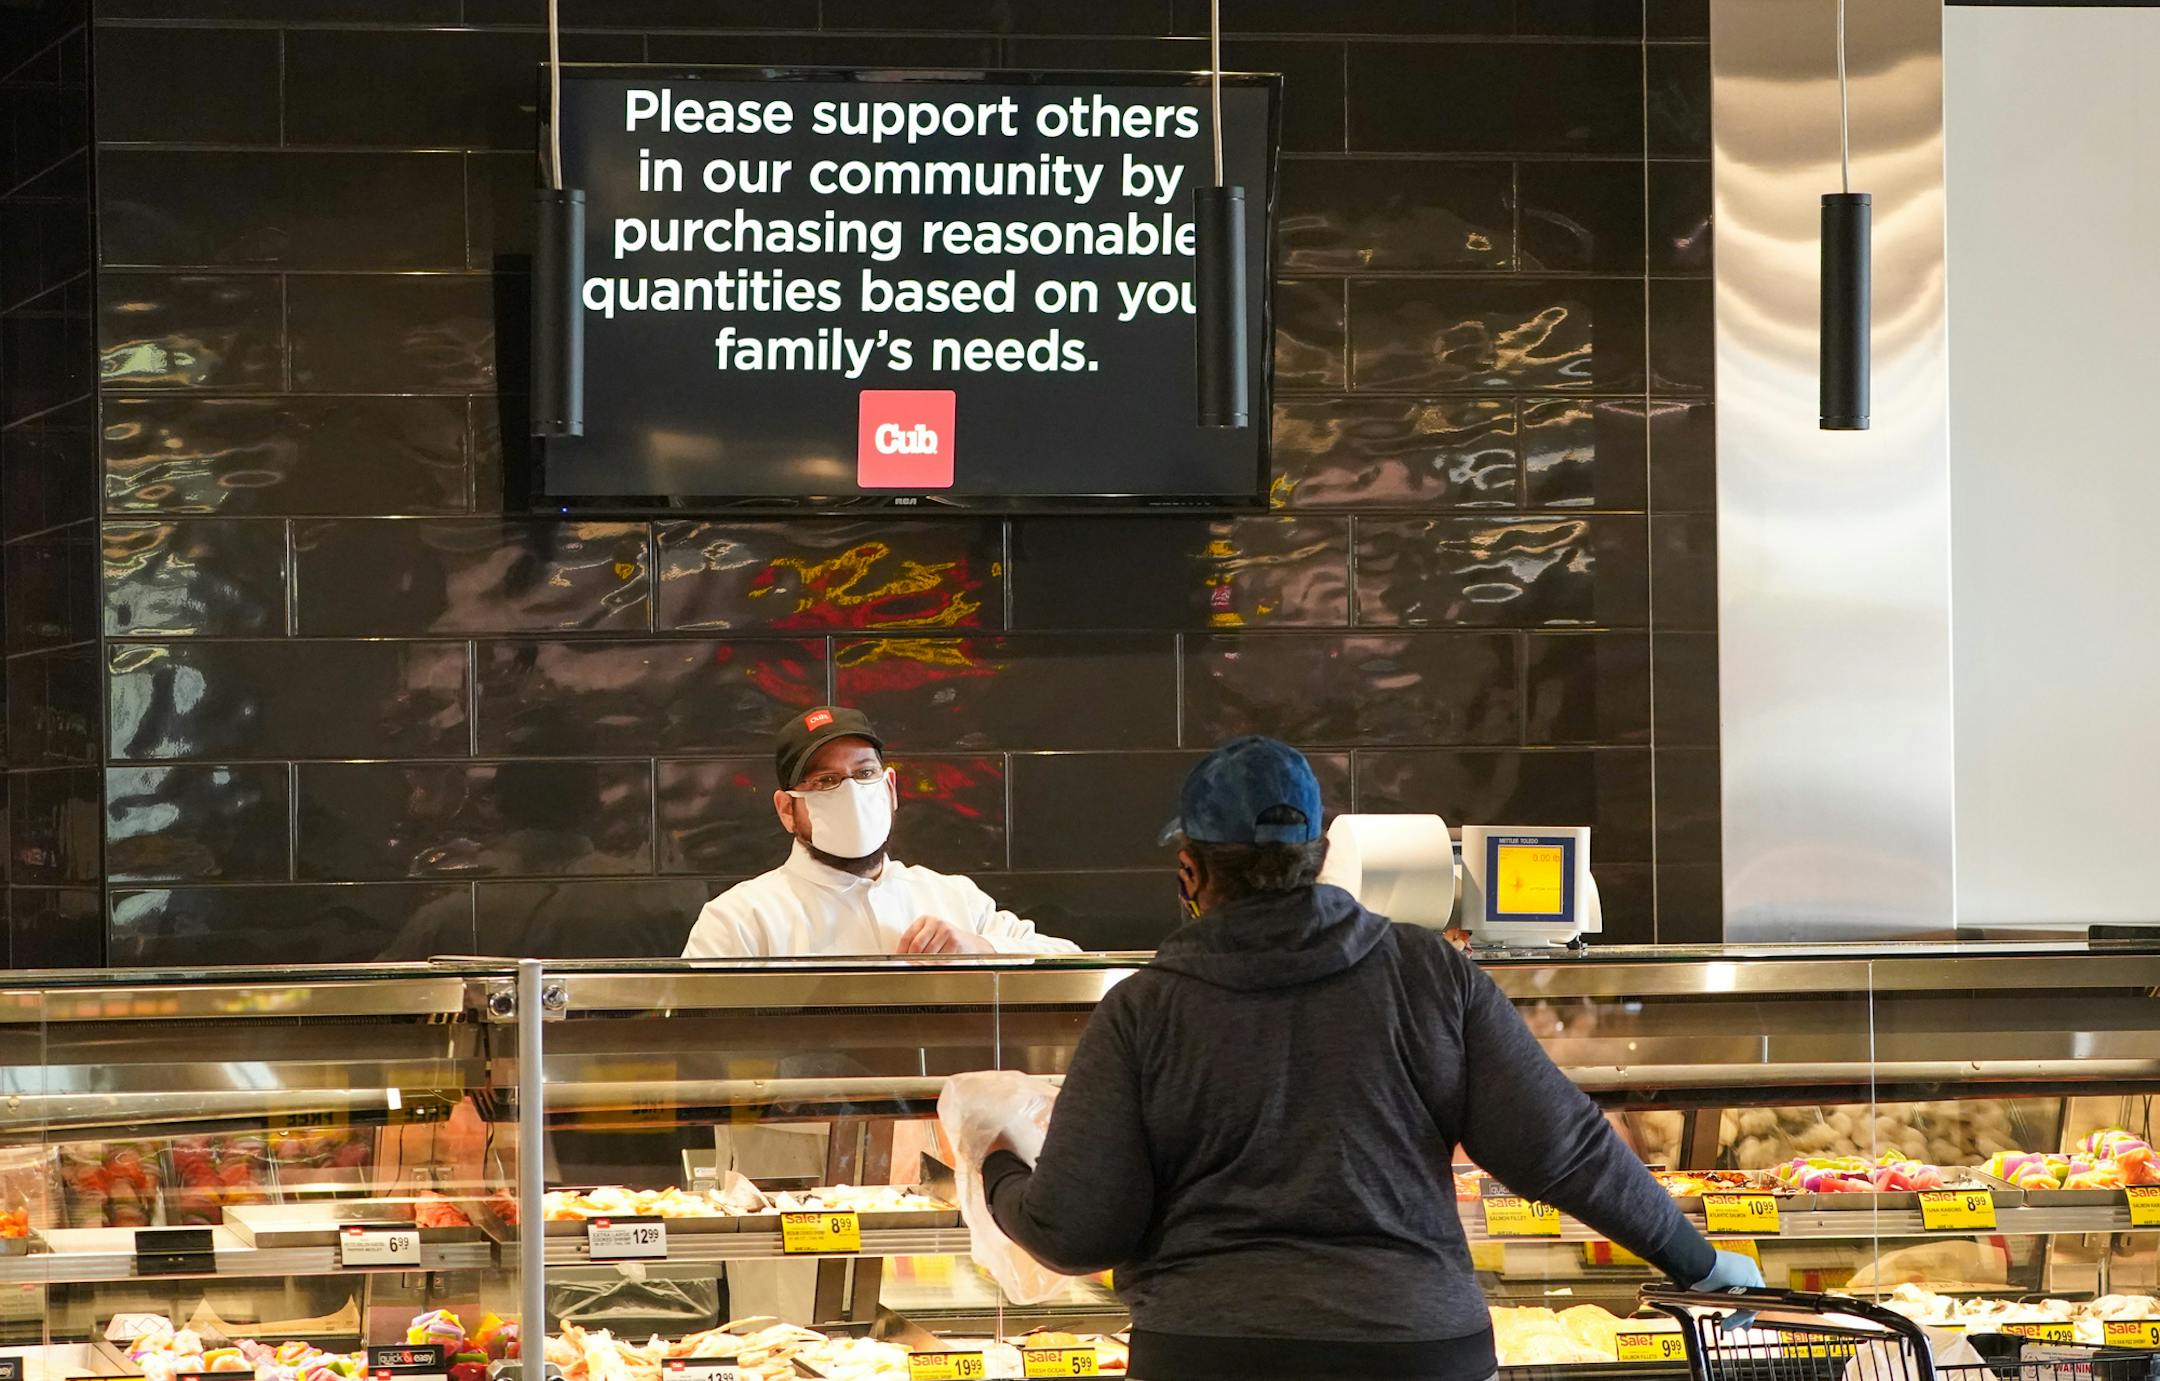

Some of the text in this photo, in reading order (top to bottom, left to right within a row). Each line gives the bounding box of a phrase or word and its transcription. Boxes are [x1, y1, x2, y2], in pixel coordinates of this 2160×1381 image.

[625, 88, 1199, 144] Please support others
[638, 148, 1186, 205] in our community by
[614, 208, 902, 262] purchasing
[582, 268, 842, 319] quantities
[861, 268, 1016, 313] based
[1034, 280, 1099, 314] on
[715, 326, 1100, 379] family’s needs.
[875, 423, 938, 455] Cub
[1708, 1194, 1741, 1204] Sale!
[1922, 1190, 1956, 1202] Sale!
[785, 1213, 822, 1224] Sale!
[2108, 1322, 2142, 1335] Sale!
[1620, 1334, 1653, 1347] Sale!
[912, 1353, 948, 1366] Sale!
[1028, 1349, 1062, 1363] Sale!
